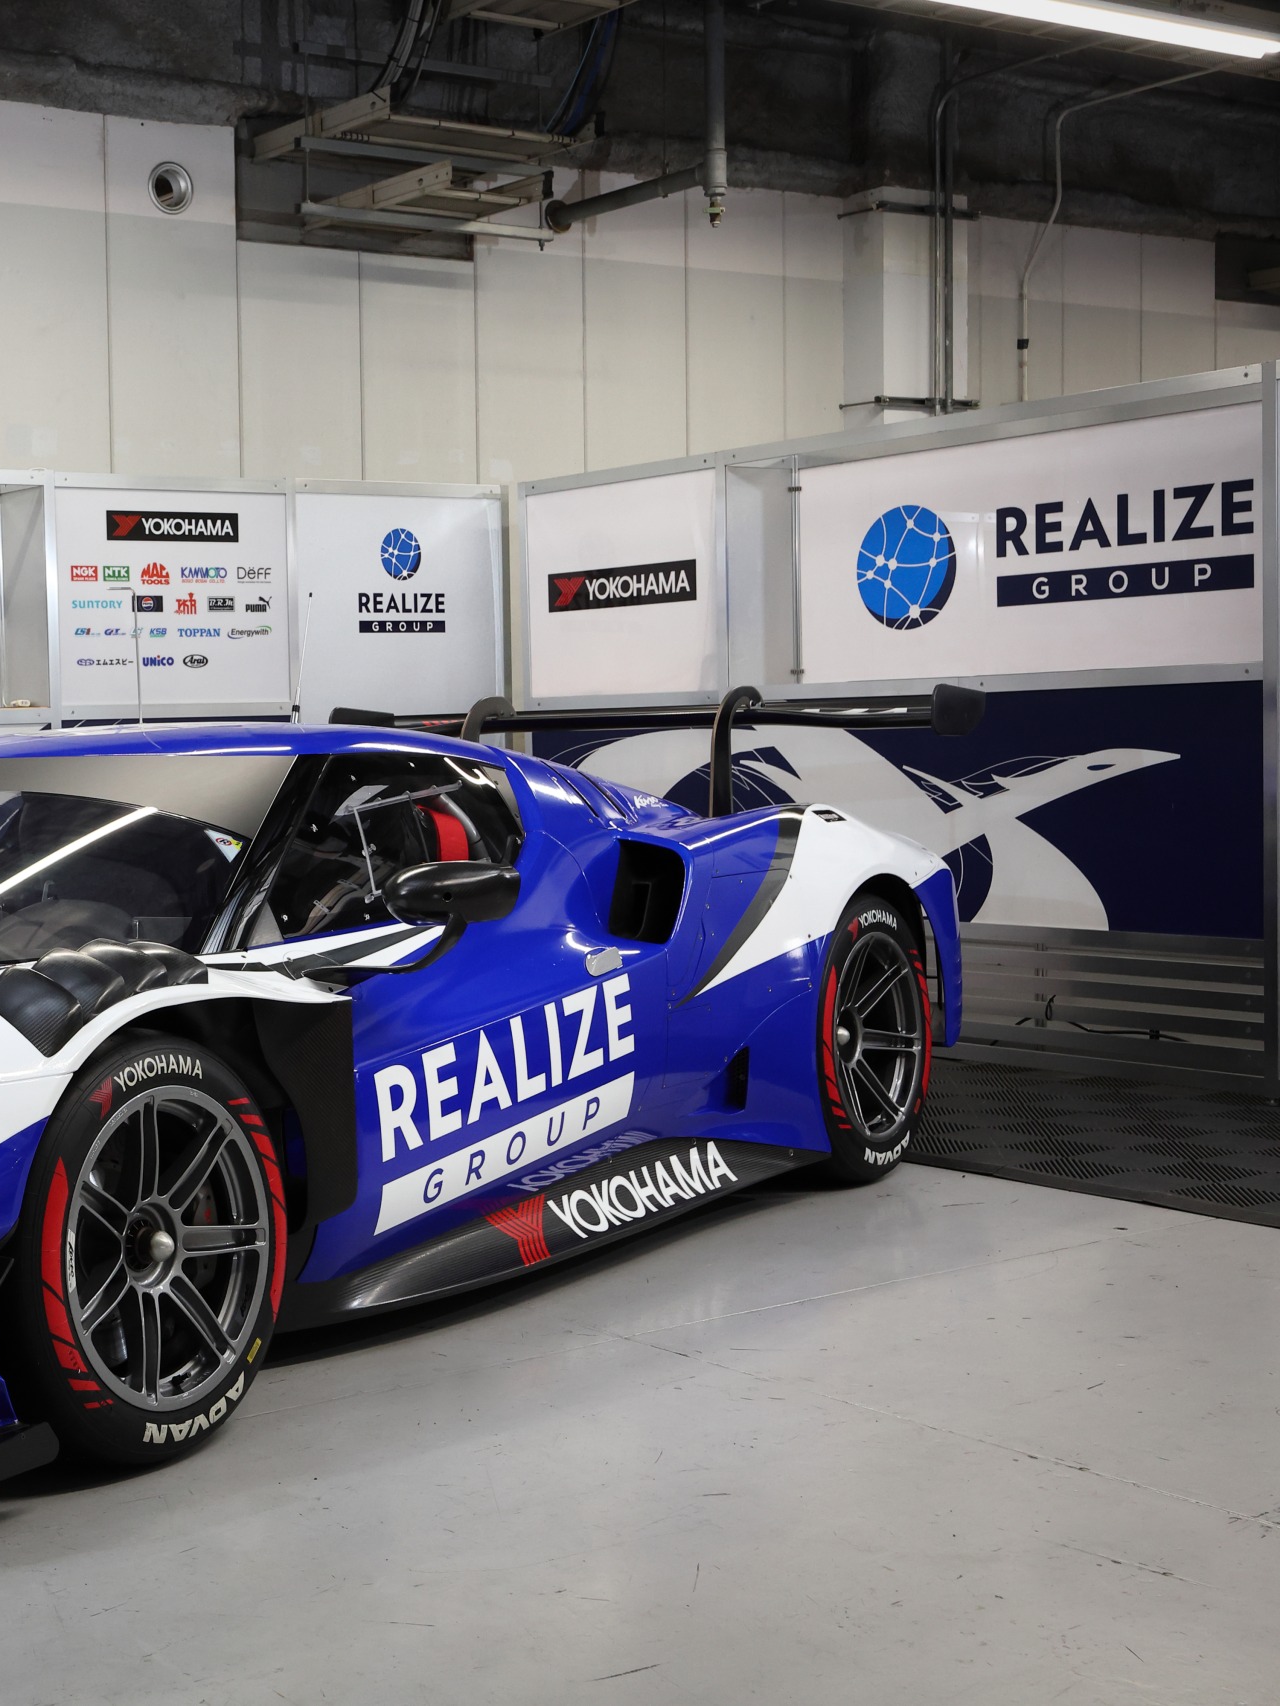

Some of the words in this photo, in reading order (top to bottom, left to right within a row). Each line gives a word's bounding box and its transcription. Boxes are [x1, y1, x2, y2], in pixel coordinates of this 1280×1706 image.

[141, 518, 234, 537] YOKOHAMA
[996, 478, 1254, 558] REALIZE
[73, 566, 96, 577] NGK
[105, 567, 128, 577] NTK
[585, 569, 690, 601] YOKOHAMA
[1032, 563, 1212, 600] GROUP
[245, 604, 267, 613] PUMA
[358, 593, 446, 613] REALIZE
[177, 628, 221, 638] TOPPAN
[231, 628, 269, 637] Energywith
[372, 622, 434, 632] GROUP
[858, 909, 898, 931] YOKOHAMA
[113, 1054, 204, 1093] YOKOHAMA
[373, 973, 635, 1164] REALIZE
[422, 1096, 600, 1205] GROUP
[864, 1130, 910, 1166] ADVAN
[547, 1140, 739, 1239] YOKOHAMA
[143, 1370, 246, 1444] ADVAN
